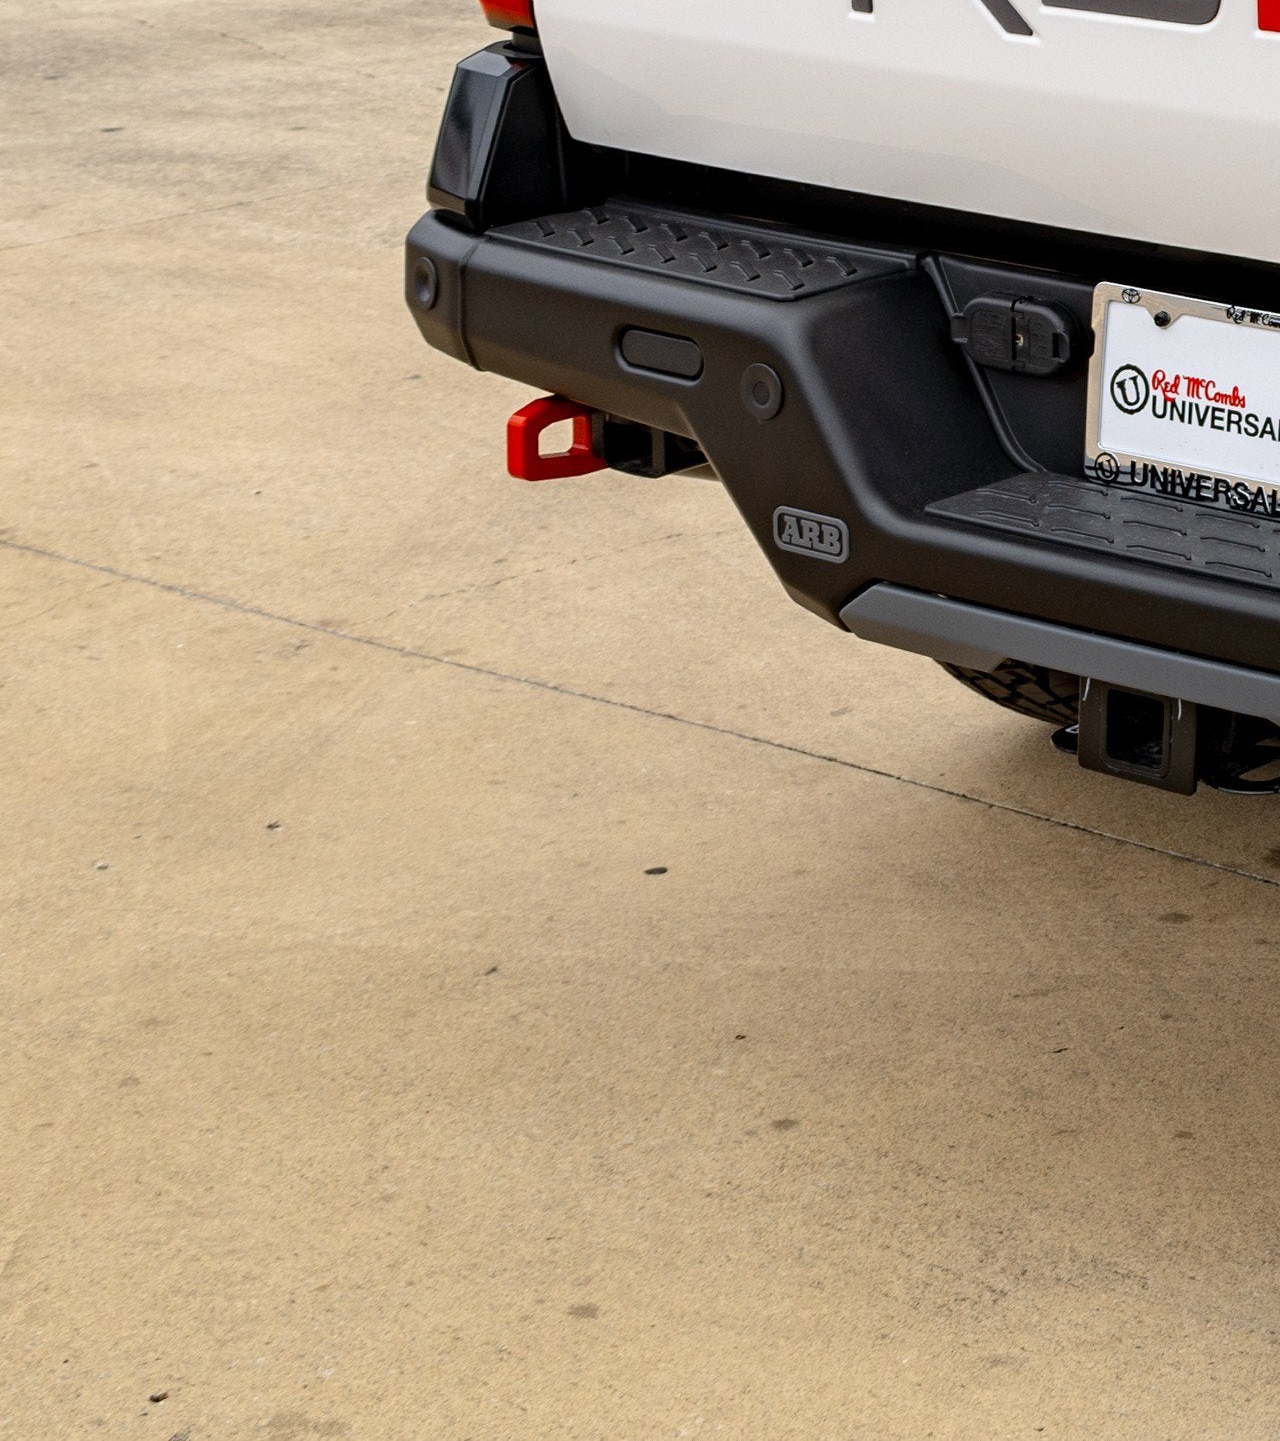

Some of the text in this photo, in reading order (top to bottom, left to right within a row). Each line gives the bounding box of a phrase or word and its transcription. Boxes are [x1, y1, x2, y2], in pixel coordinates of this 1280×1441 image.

[1151, 369, 1247, 409] Red McCombs
[781, 514, 842, 555] ARB
